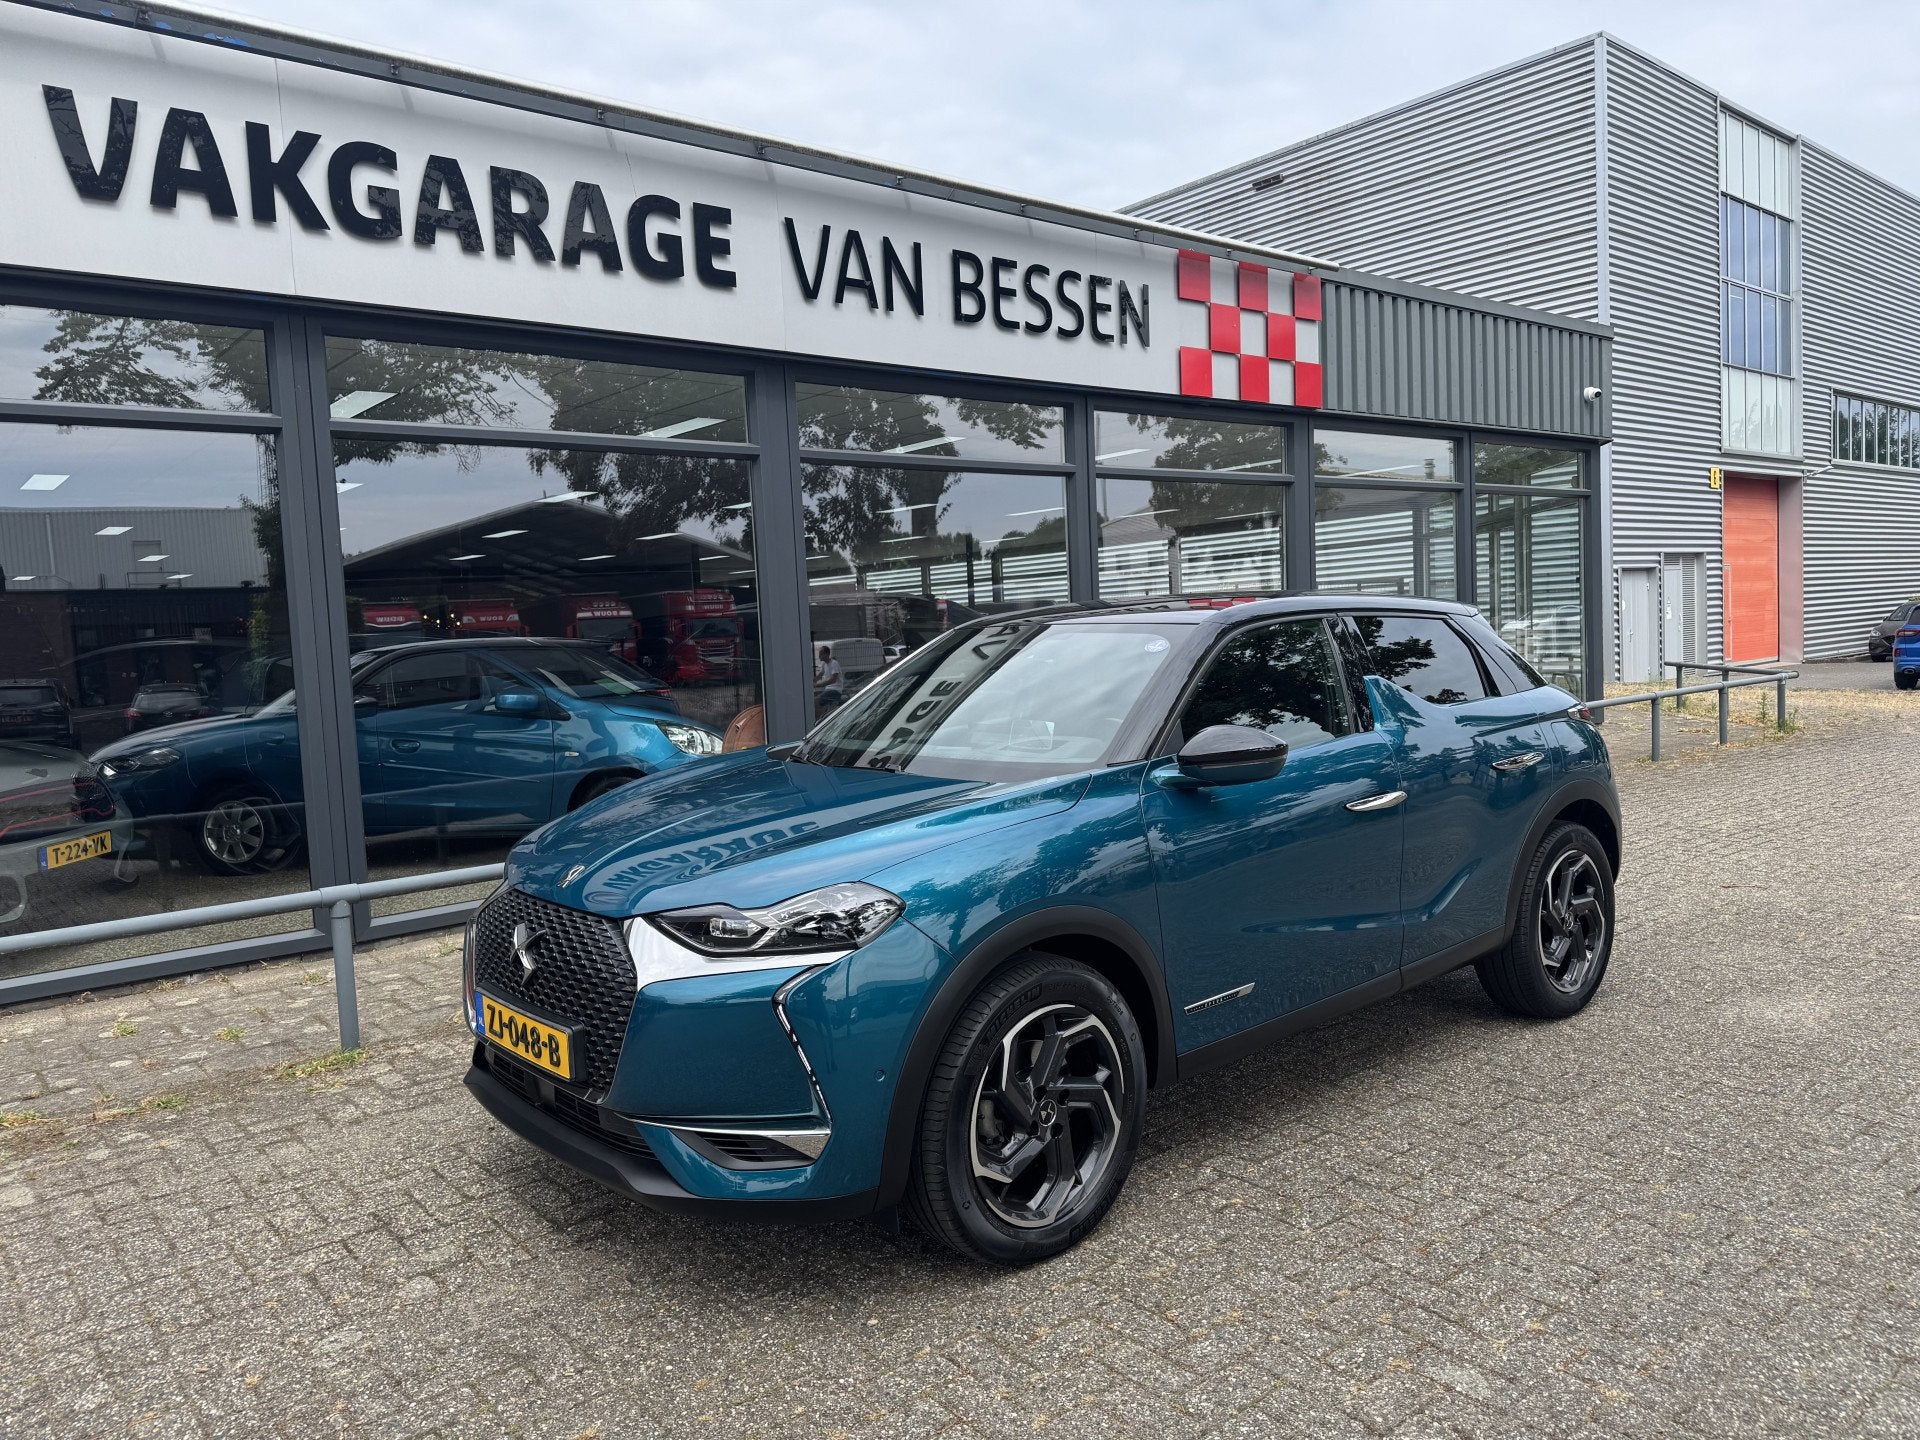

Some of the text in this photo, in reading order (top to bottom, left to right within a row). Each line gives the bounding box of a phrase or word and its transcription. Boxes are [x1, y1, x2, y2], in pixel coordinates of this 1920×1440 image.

[41, 84, 1151, 348] VAKGARAGE VAN BESSEN
[52, 835, 107, 864] T-224-VK
[486, 1003, 561, 1068] ZJ-048-B
